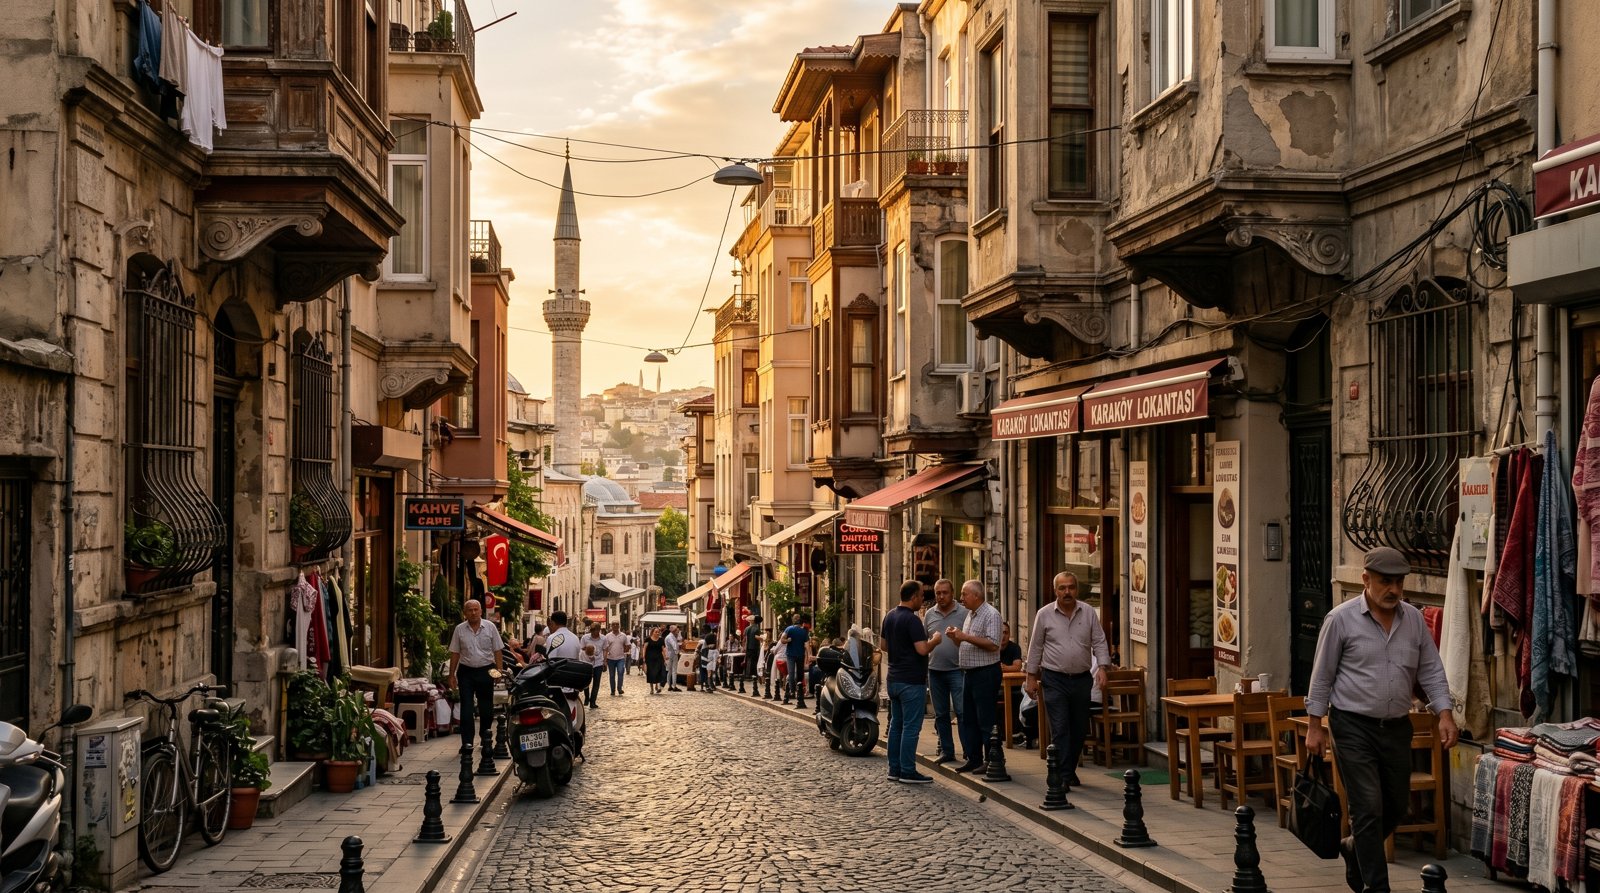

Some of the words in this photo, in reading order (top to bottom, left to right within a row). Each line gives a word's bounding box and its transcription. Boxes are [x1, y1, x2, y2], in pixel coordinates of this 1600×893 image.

[1569, 164, 1600, 202] KA
[1091, 396, 1133, 425] KARAKÖY
[1137, 388, 1195, 419] LOKANTASI
[997, 413, 1027, 435] KARAKÖY
[1030, 408, 1070, 433] LOKANTASI
[409, 503, 460, 514] KAHVE
[840, 542, 880, 552] TEKSTİL
